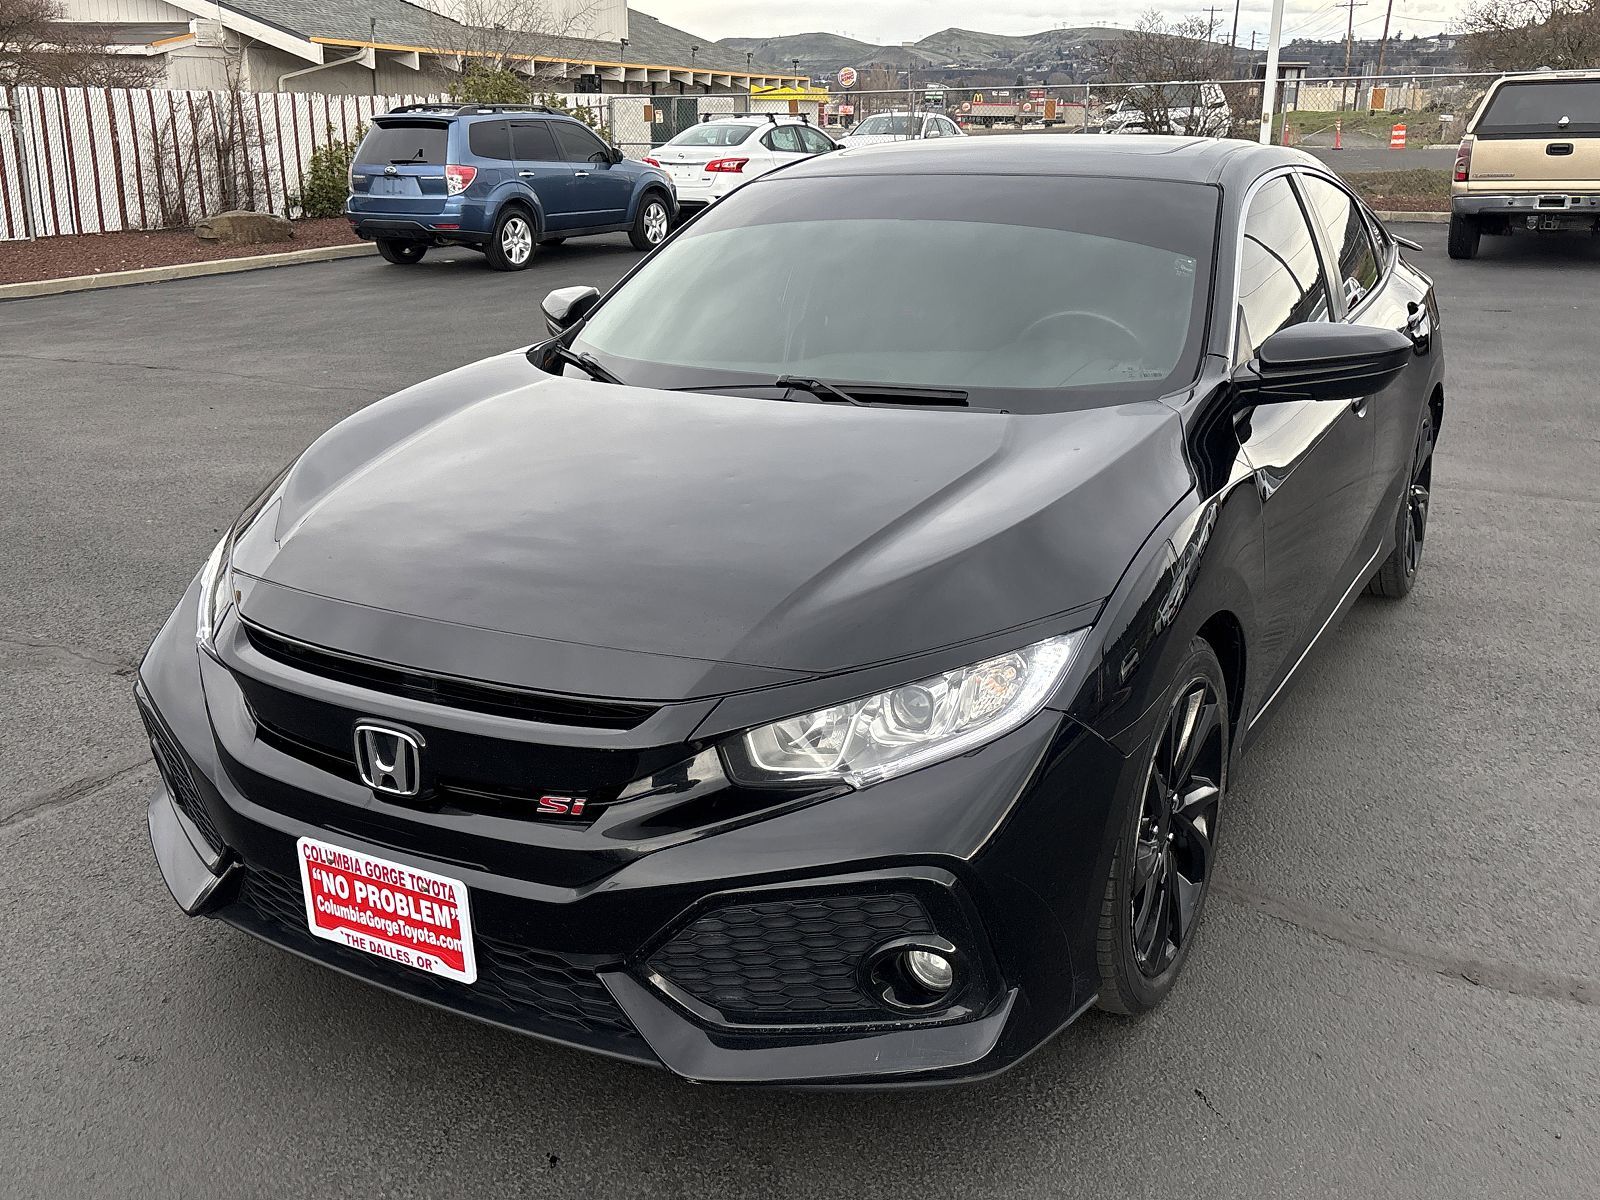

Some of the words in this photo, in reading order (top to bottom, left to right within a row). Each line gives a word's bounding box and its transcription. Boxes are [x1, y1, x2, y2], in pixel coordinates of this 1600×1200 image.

[536, 796, 587, 816] Si
[303, 843, 362, 875] COLUMBIA
[365, 861, 406, 888] GORGE
[408, 873, 457, 902] TOYOTA
[316, 895, 463, 953] ColumbiaGorgeToyota.com
[345, 933, 367, 951] THE
[369, 938, 414, 965] DALLES,
[416, 955, 433, 971] OR
